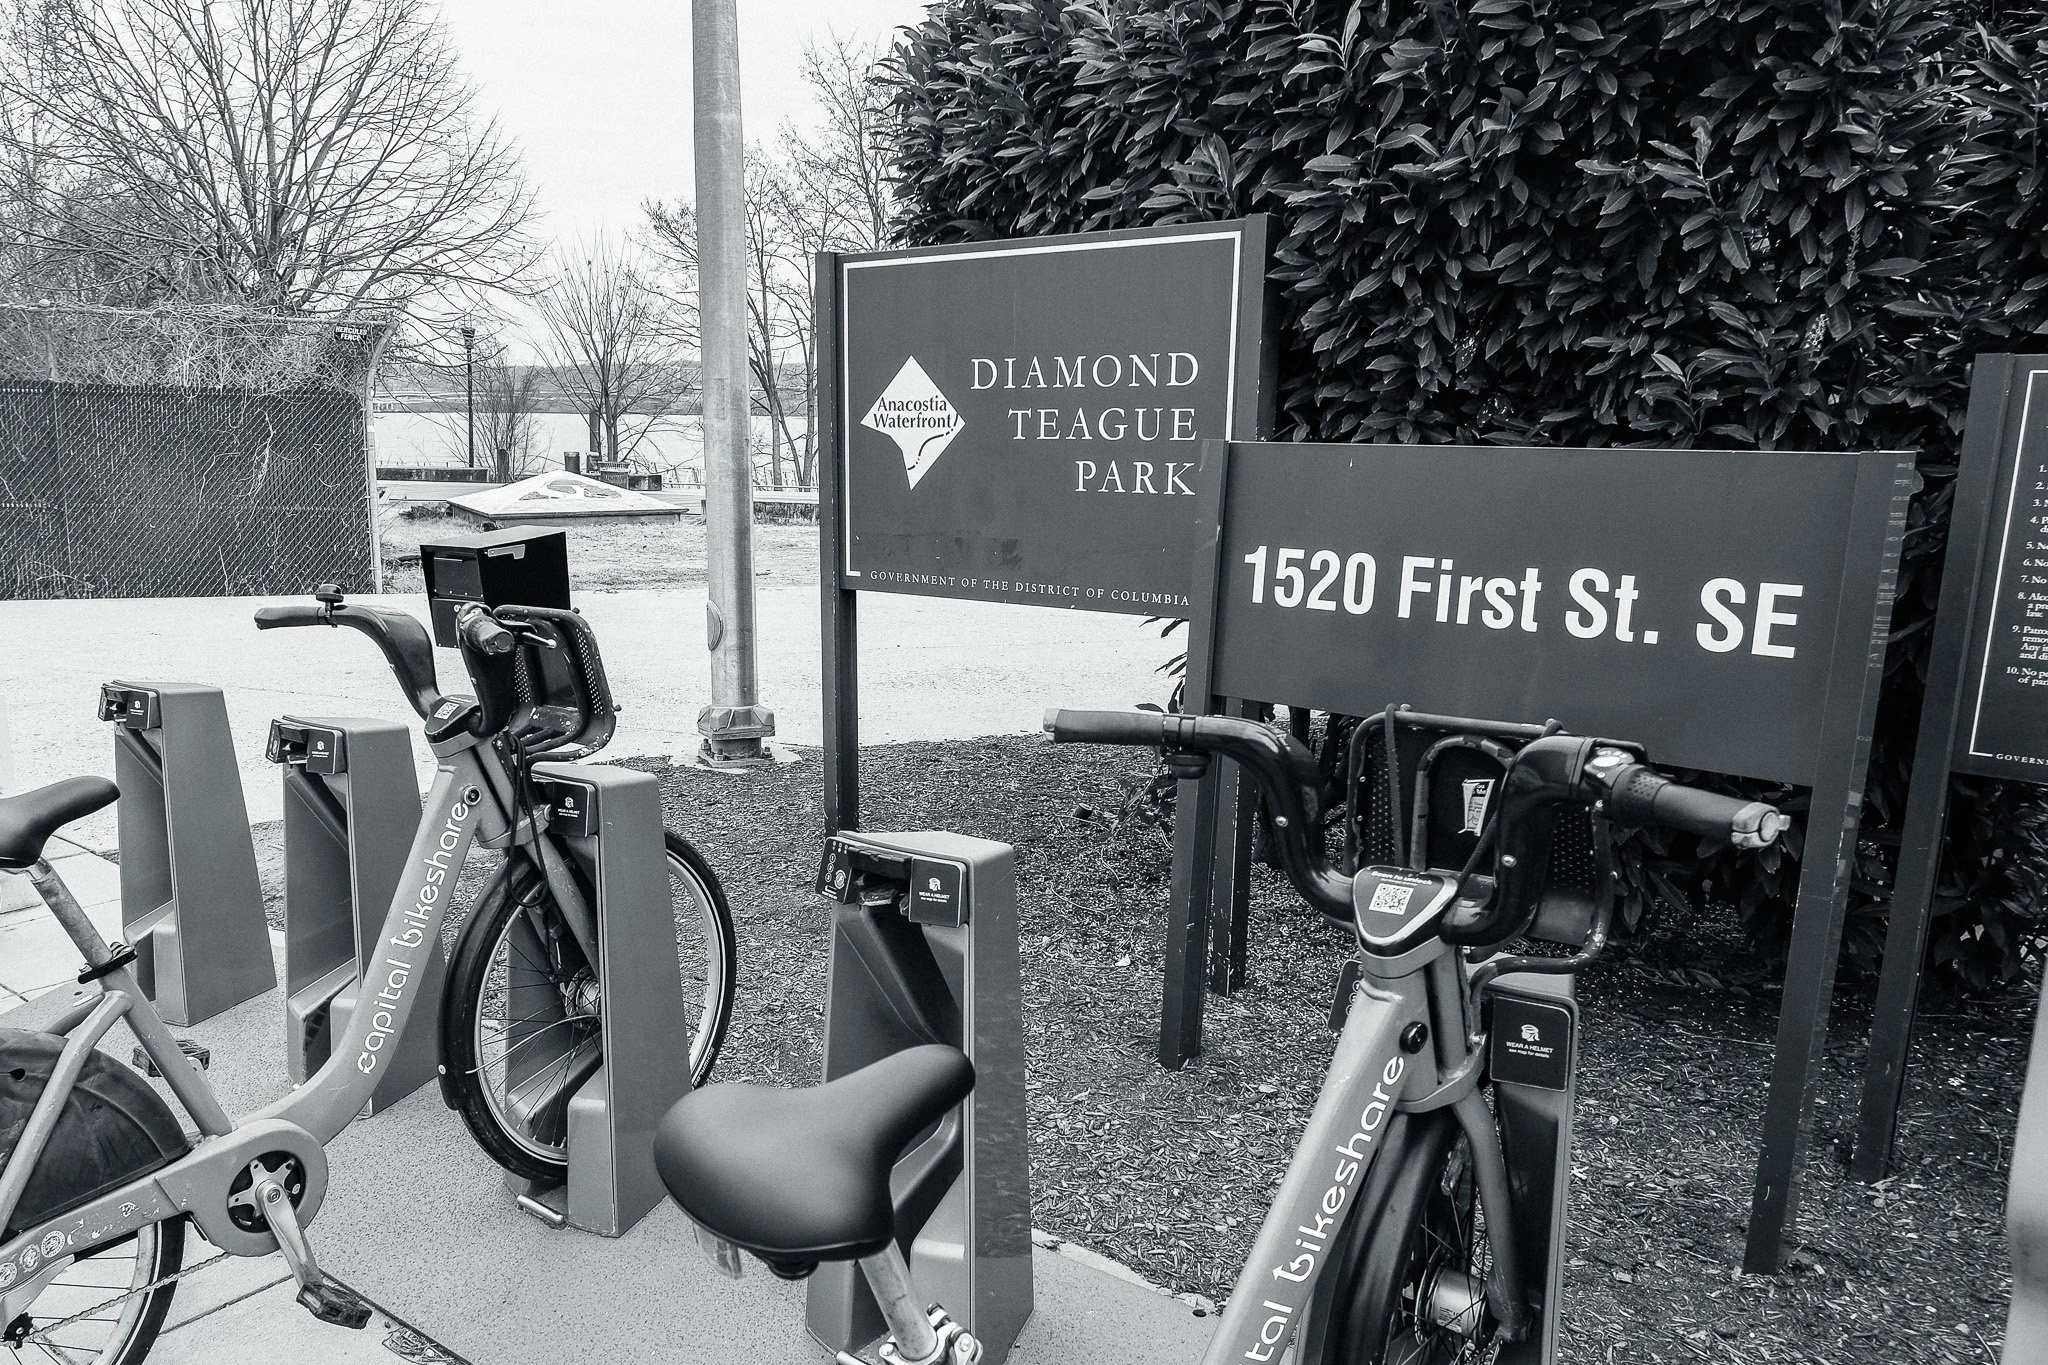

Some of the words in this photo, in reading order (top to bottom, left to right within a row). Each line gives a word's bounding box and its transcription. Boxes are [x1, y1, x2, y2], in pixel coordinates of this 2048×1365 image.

[970, 352, 1199, 390] DIAMOND
[877, 395, 947, 412] Anacostia
[873, 412, 951, 428] Waterfront
[1008, 408, 1197, 441] TEAGUE
[1075, 460, 1196, 495] PARK
[2023, 558, 2032, 567] 6.
[870, 570, 956, 586] GOVERNMENT
[961, 578, 978, 588] OF
[983, 579, 1009, 591] THE
[1015, 581, 1080, 597] DISTRICT
[1086, 588, 1105, 599] OF
[1111, 589, 1190, 606] COLUMBIA
[2020, 574, 2030, 583] 7.
[2030, 575, 2048, 584] No
[1243, 545, 1378, 616] 1520
[1397, 555, 1543, 634] First
[1564, 567, 1660, 645] St.
[1695, 577, 1804, 660] SE
[2023, 625, 2048, 635] Patro
[2020, 642, 2041, 652] Any
[2006, 666, 2019, 675] 10.
[2021, 667, 2037, 676] No
[2017, 676, 2031, 684] of
[388, 800, 470, 949] bikeshare
[357, 958, 412, 1075] capital
[1271, 1054, 1405, 1284] bikeshare
